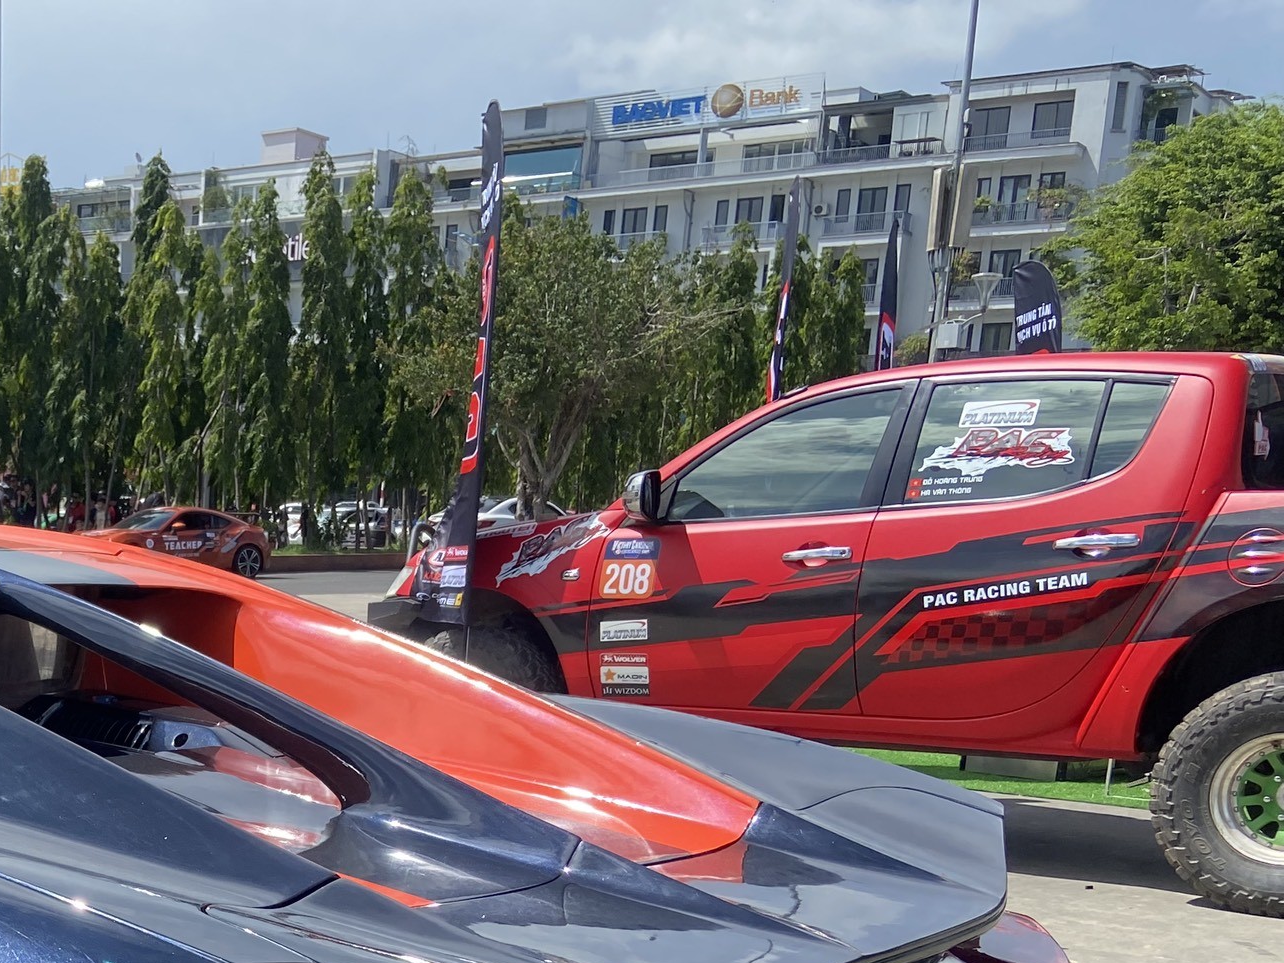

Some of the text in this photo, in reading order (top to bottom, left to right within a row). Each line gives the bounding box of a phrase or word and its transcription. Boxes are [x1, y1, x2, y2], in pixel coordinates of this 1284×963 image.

[749, 85, 800, 107] Bank
[961, 411, 1034, 426] PLATINUM
[603, 563, 651, 595] 208
[923, 572, 1088, 608] PAC RACING TEAM
[602, 629, 646, 640] PLATINUM
